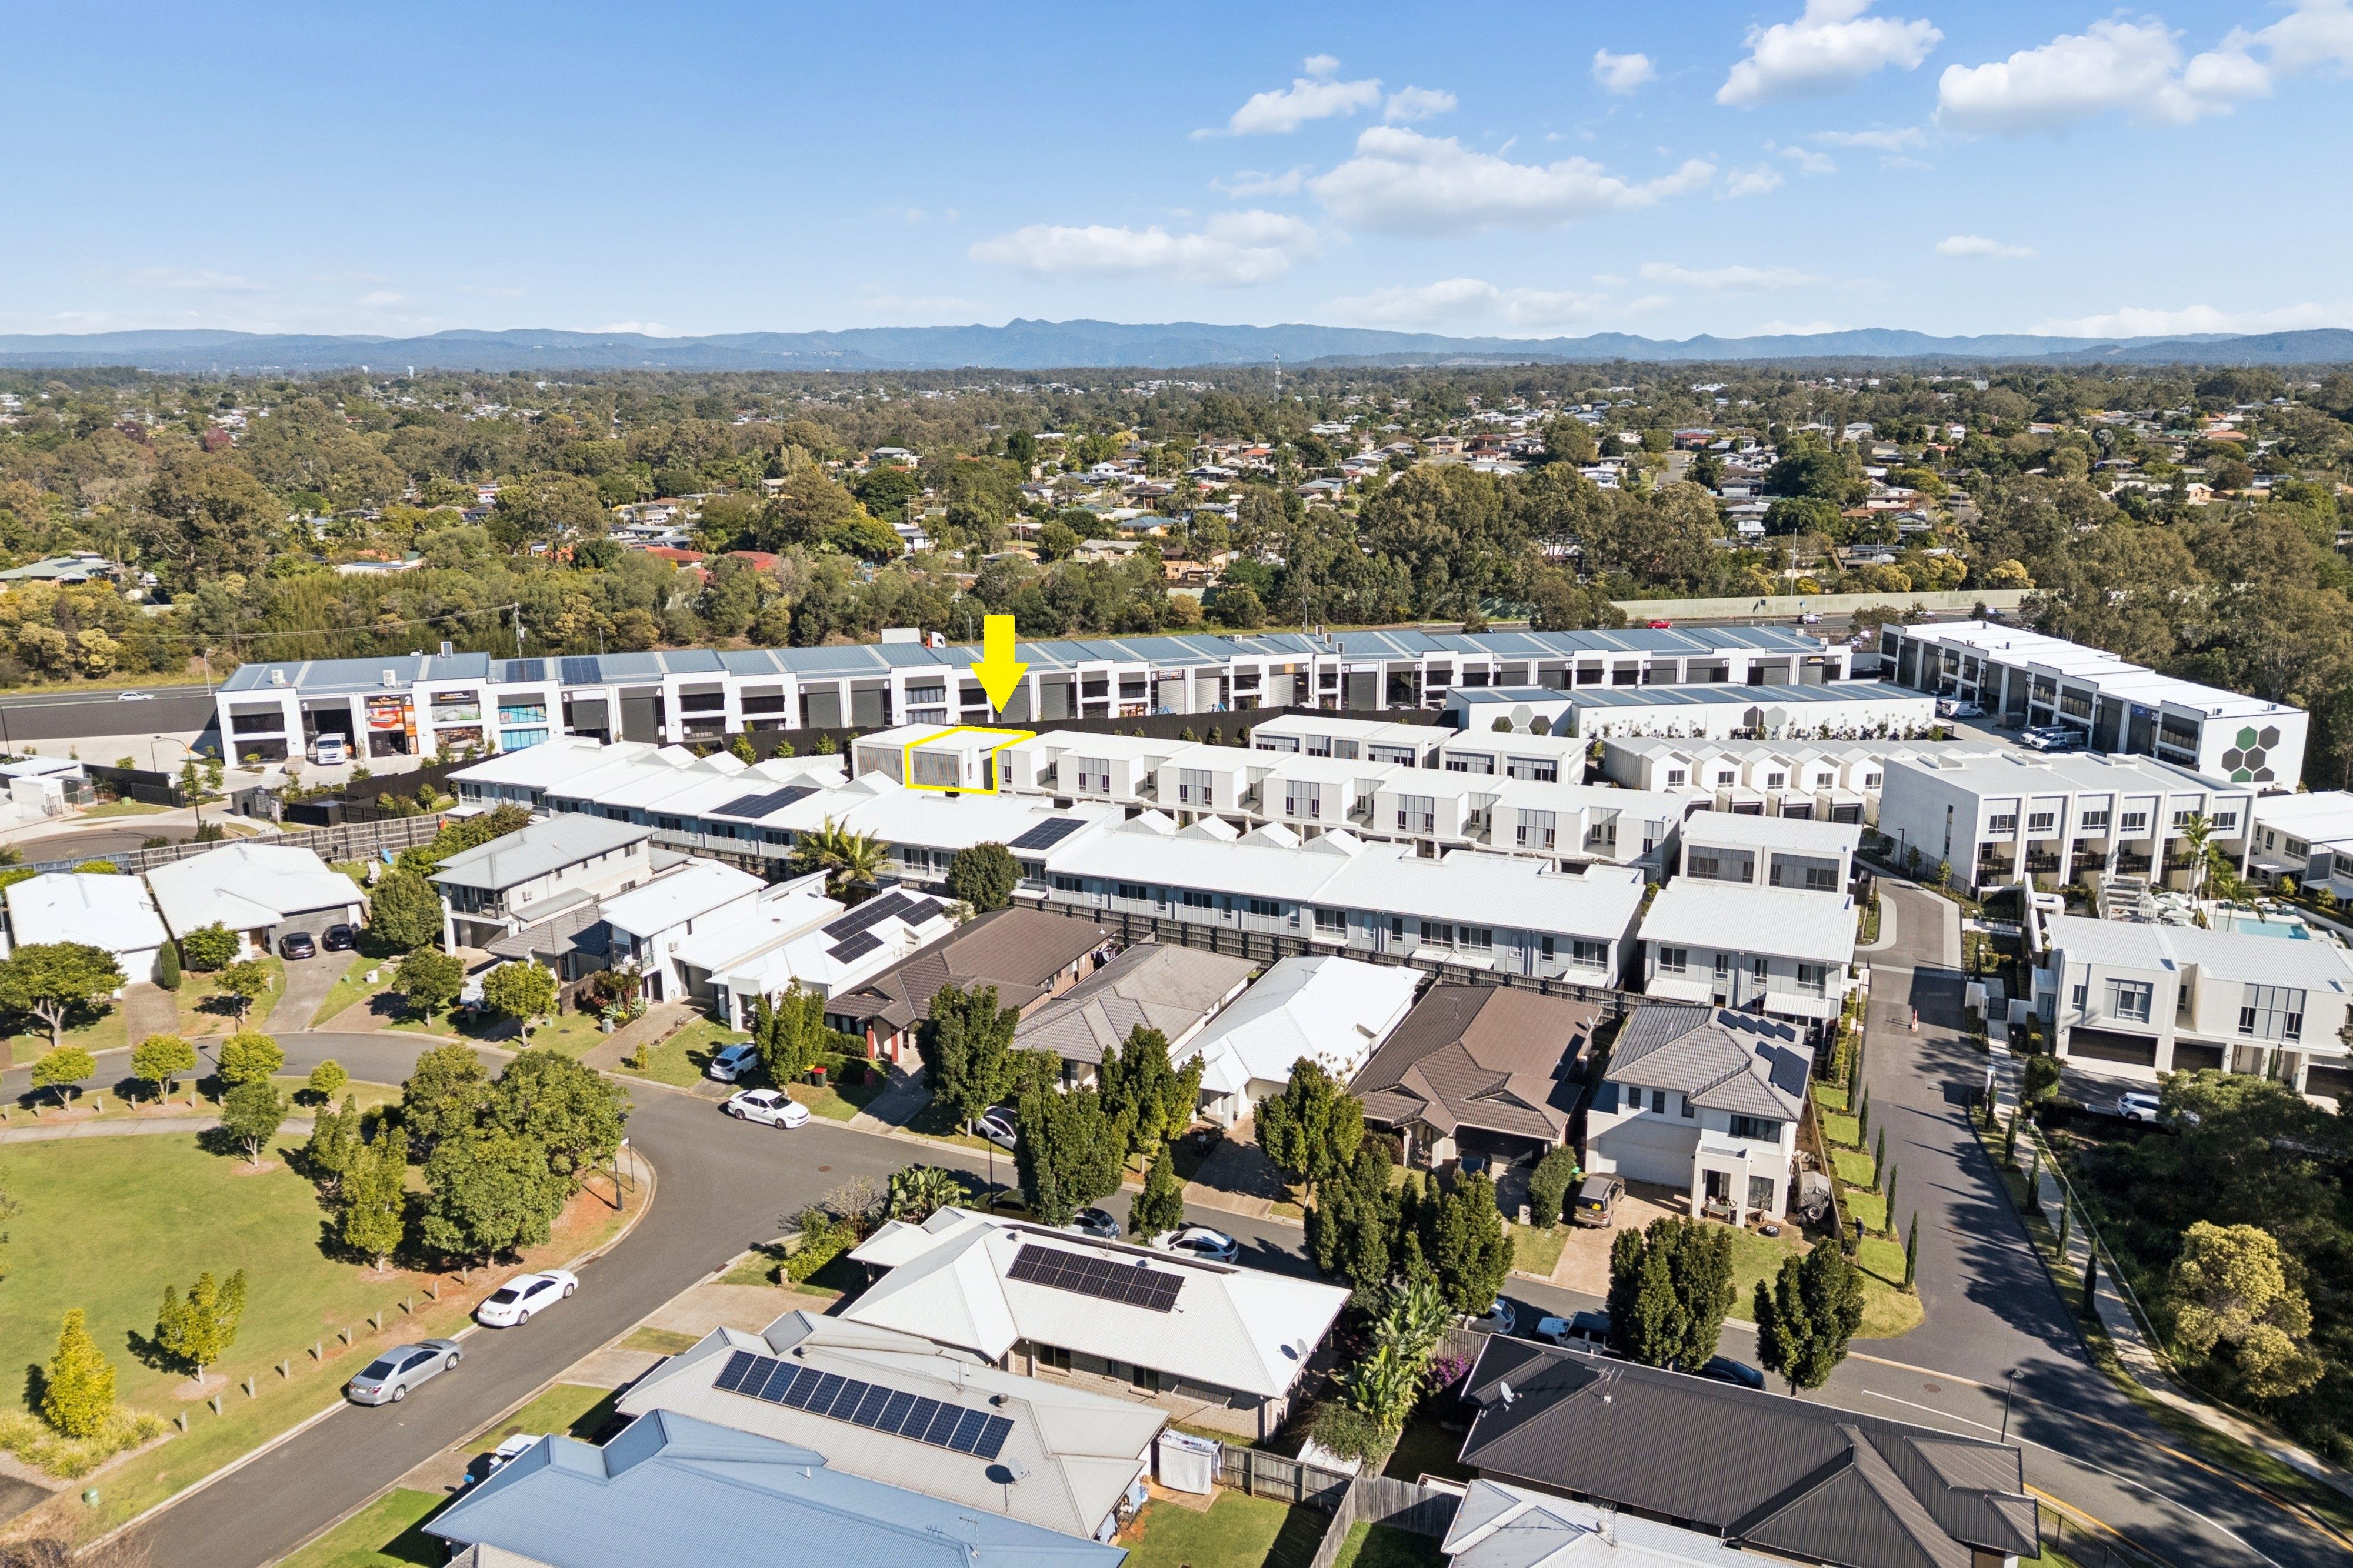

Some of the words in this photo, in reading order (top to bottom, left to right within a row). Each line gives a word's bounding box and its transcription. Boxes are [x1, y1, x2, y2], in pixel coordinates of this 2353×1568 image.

[1834, 656, 1841, 665] 19
[1222, 668, 1229, 676] 10
[1302, 664, 1309, 672] 11
[1414, 663, 1422, 672] 13
[1071, 673, 1075, 682] 8
[1151, 673, 1156, 681] 9
[884, 680, 889, 689] 6
[656, 688, 662, 696] 4
[799, 685, 805, 694] 5
[405, 696, 411, 705] 2
[563, 693, 568, 702] 3
[2096, 697, 2102, 705] 24
[2151, 712, 2158, 721] 25
